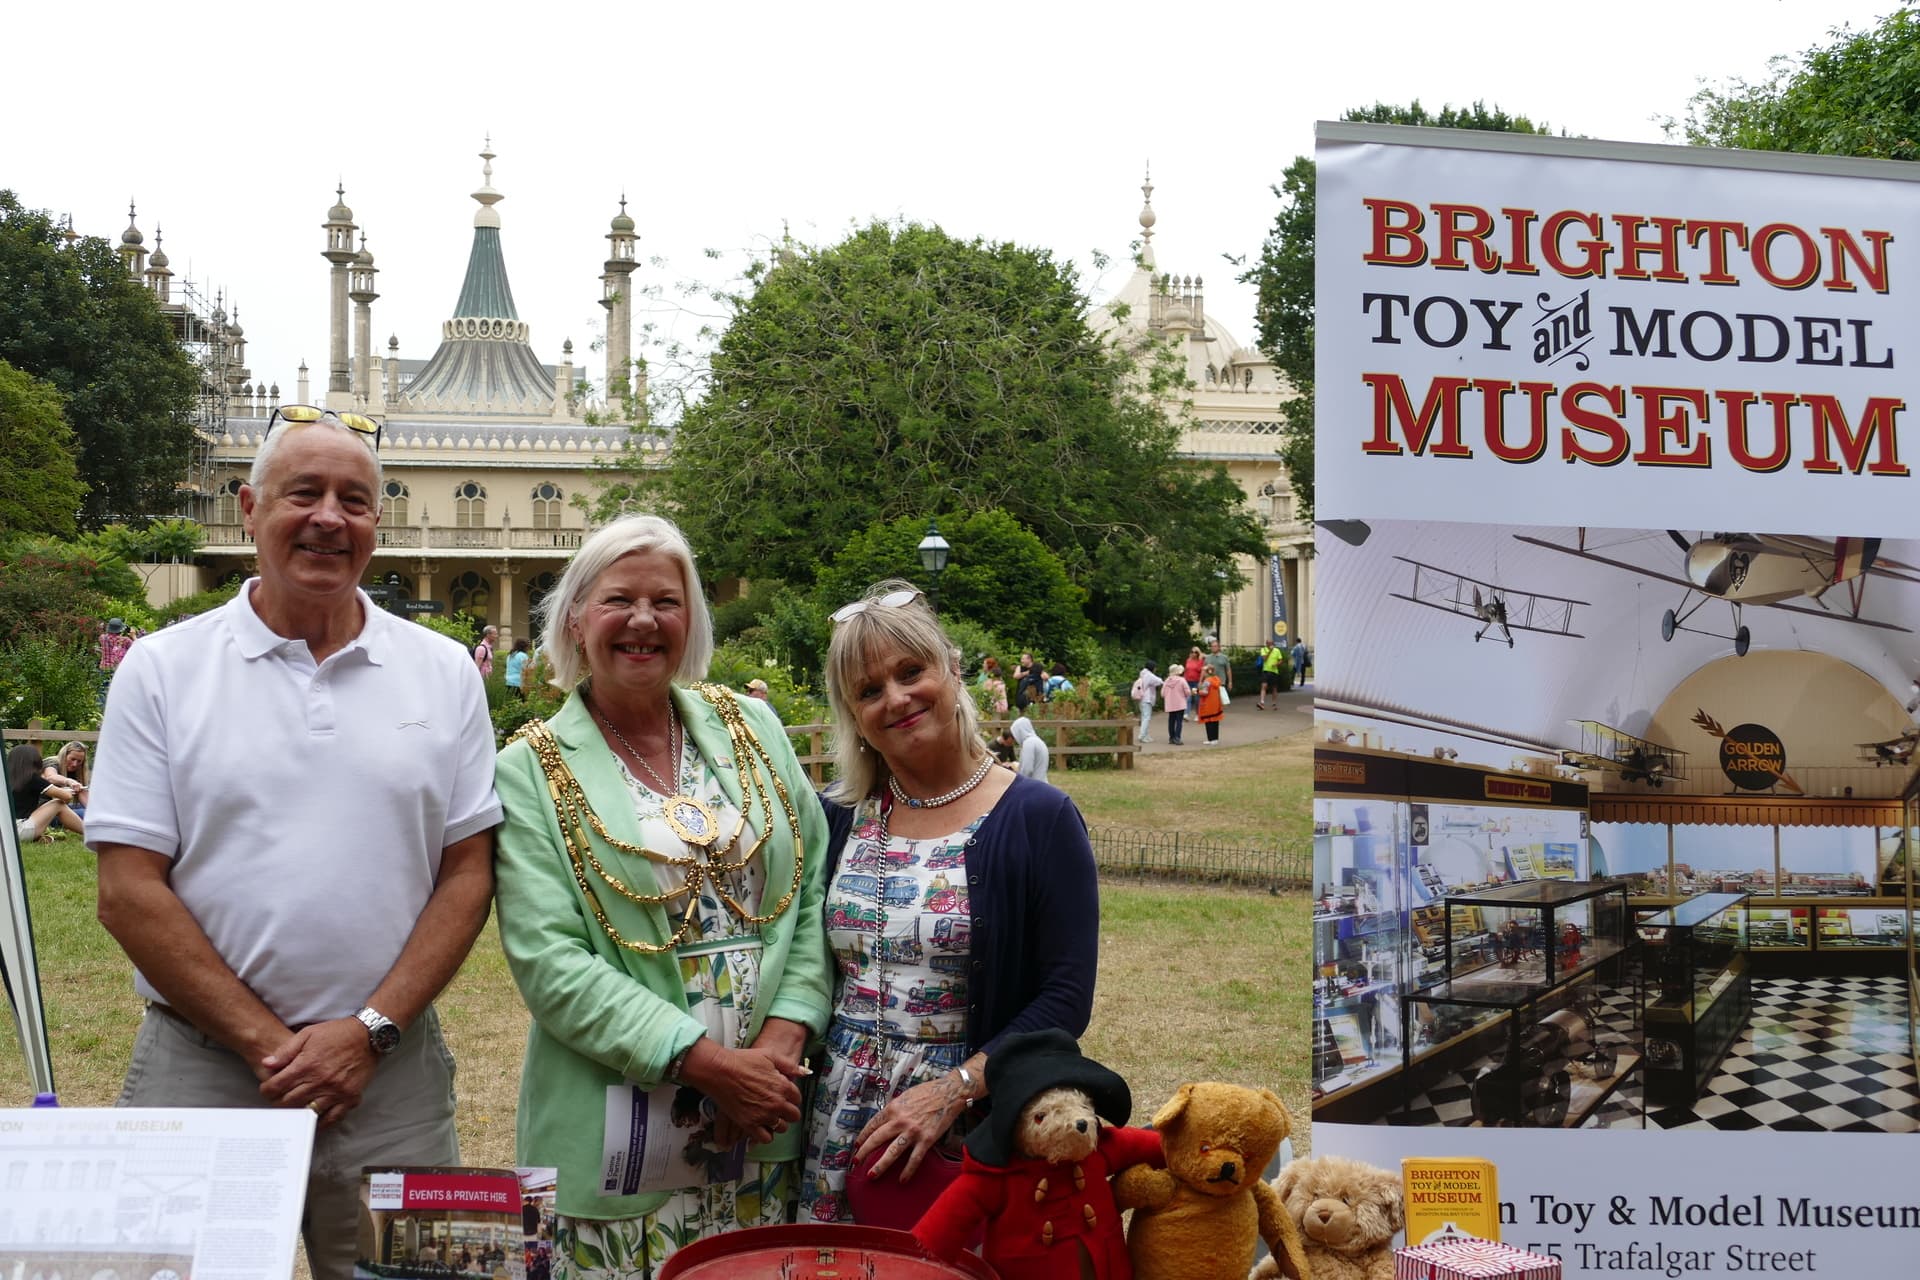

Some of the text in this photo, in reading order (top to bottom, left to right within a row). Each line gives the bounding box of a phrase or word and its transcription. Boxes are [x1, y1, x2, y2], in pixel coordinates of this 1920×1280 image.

[1362, 197, 1895, 294] BRIGHTON
[1362, 288, 1895, 370] TOY and MODEL
[1361, 373, 1911, 477] MUSEUM
[1725, 742, 1780, 755] GOLDEN
[1726, 759, 1782, 771] ARROW
[115, 1120, 184, 1132] MUSEUM
[1411, 1170, 1480, 1180] BRIGHTON
[1411, 1182, 1432, 1190] TOY
[1443, 1182, 1481, 1190] MODEL
[409, 1190, 507, 1203] EVENTS & PRIVATE HIRE
[1412, 1193, 1482, 1203] MUSEUM
[1530, 1195, 1596, 1233] Toy
[1608, 1195, 1637, 1226] &
[1649, 1194, 1765, 1227] Model
[1575, 1242, 1715, 1278] Trafalgar
[1726, 1244, 1816, 1272] Street
